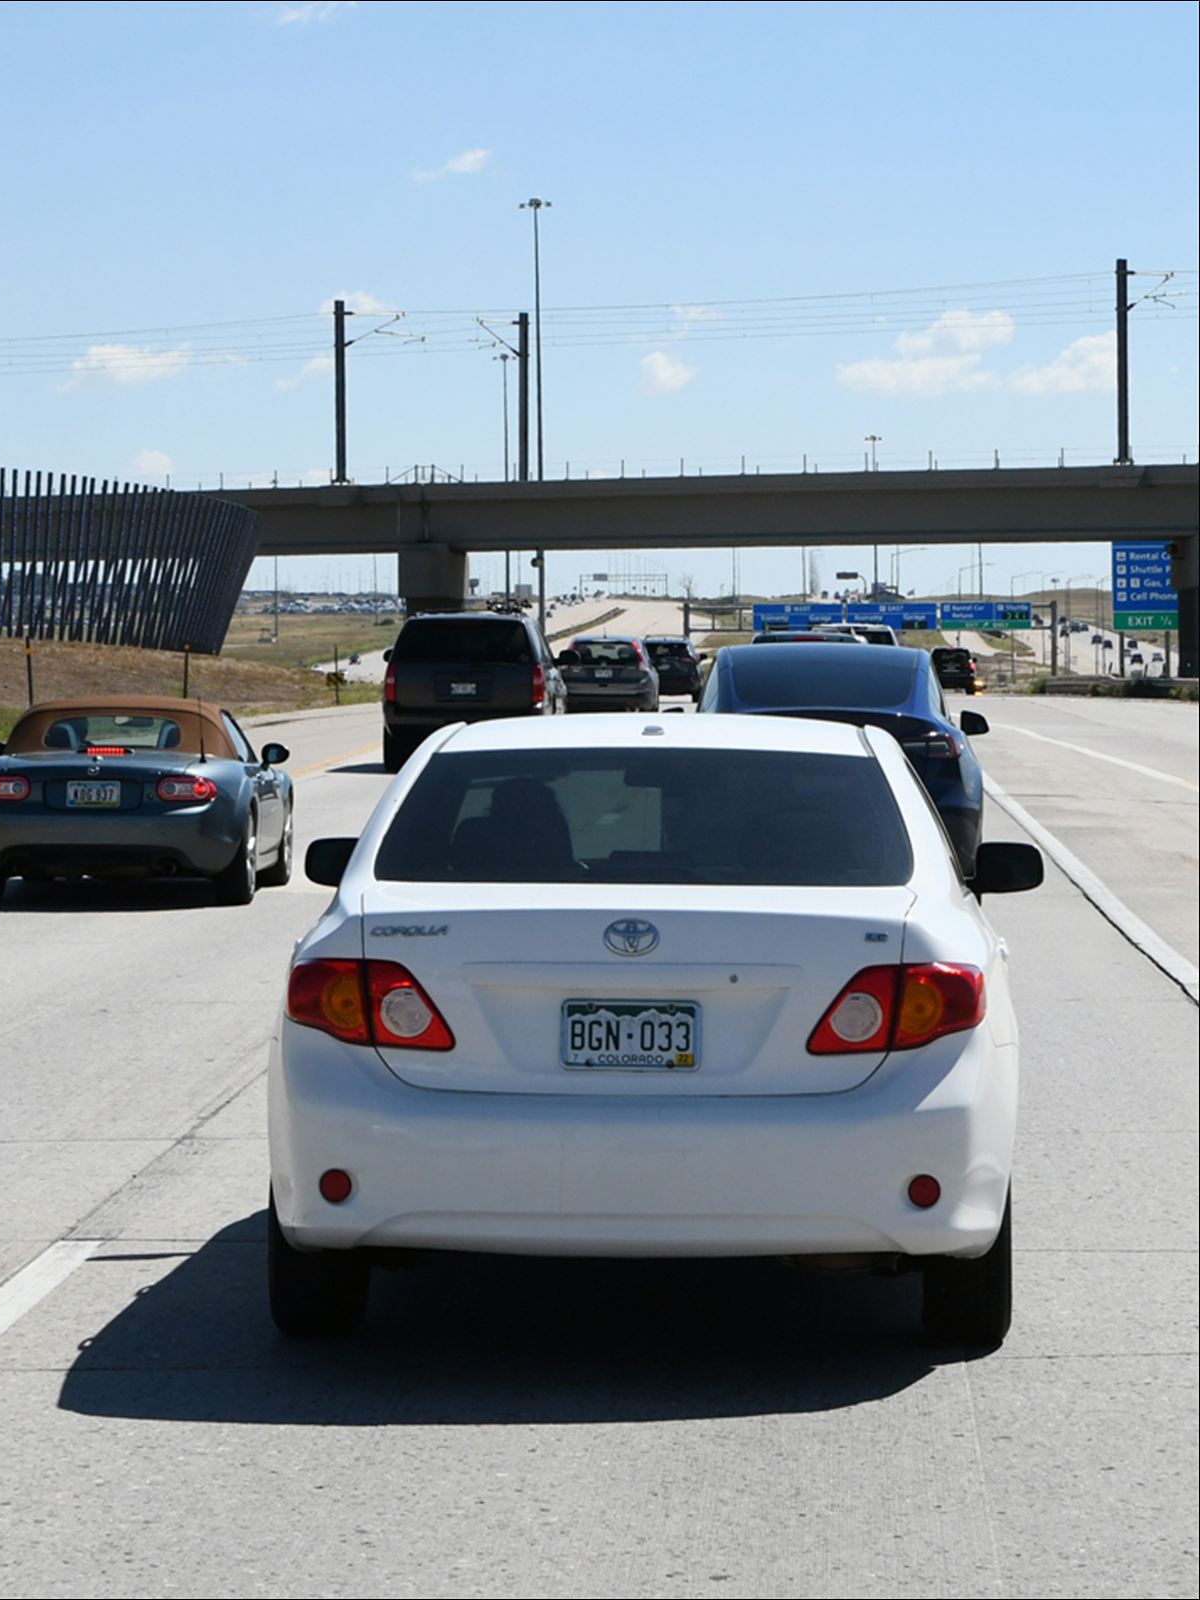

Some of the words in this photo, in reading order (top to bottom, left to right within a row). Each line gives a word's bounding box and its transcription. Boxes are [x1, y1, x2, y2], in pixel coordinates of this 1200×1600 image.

[1129, 552, 1159, 560] Rental
[1130, 565, 1163, 574] Shuttle
[1143, 579, 1163, 588] Gas,
[1130, 592, 1148, 601] Cell
[1149, 592, 1178, 600] Phone
[1128, 616, 1154, 626] EXIT
[370, 924, 449, 937] COROLLA
[598, 1054, 664, 1064] COLORADO
